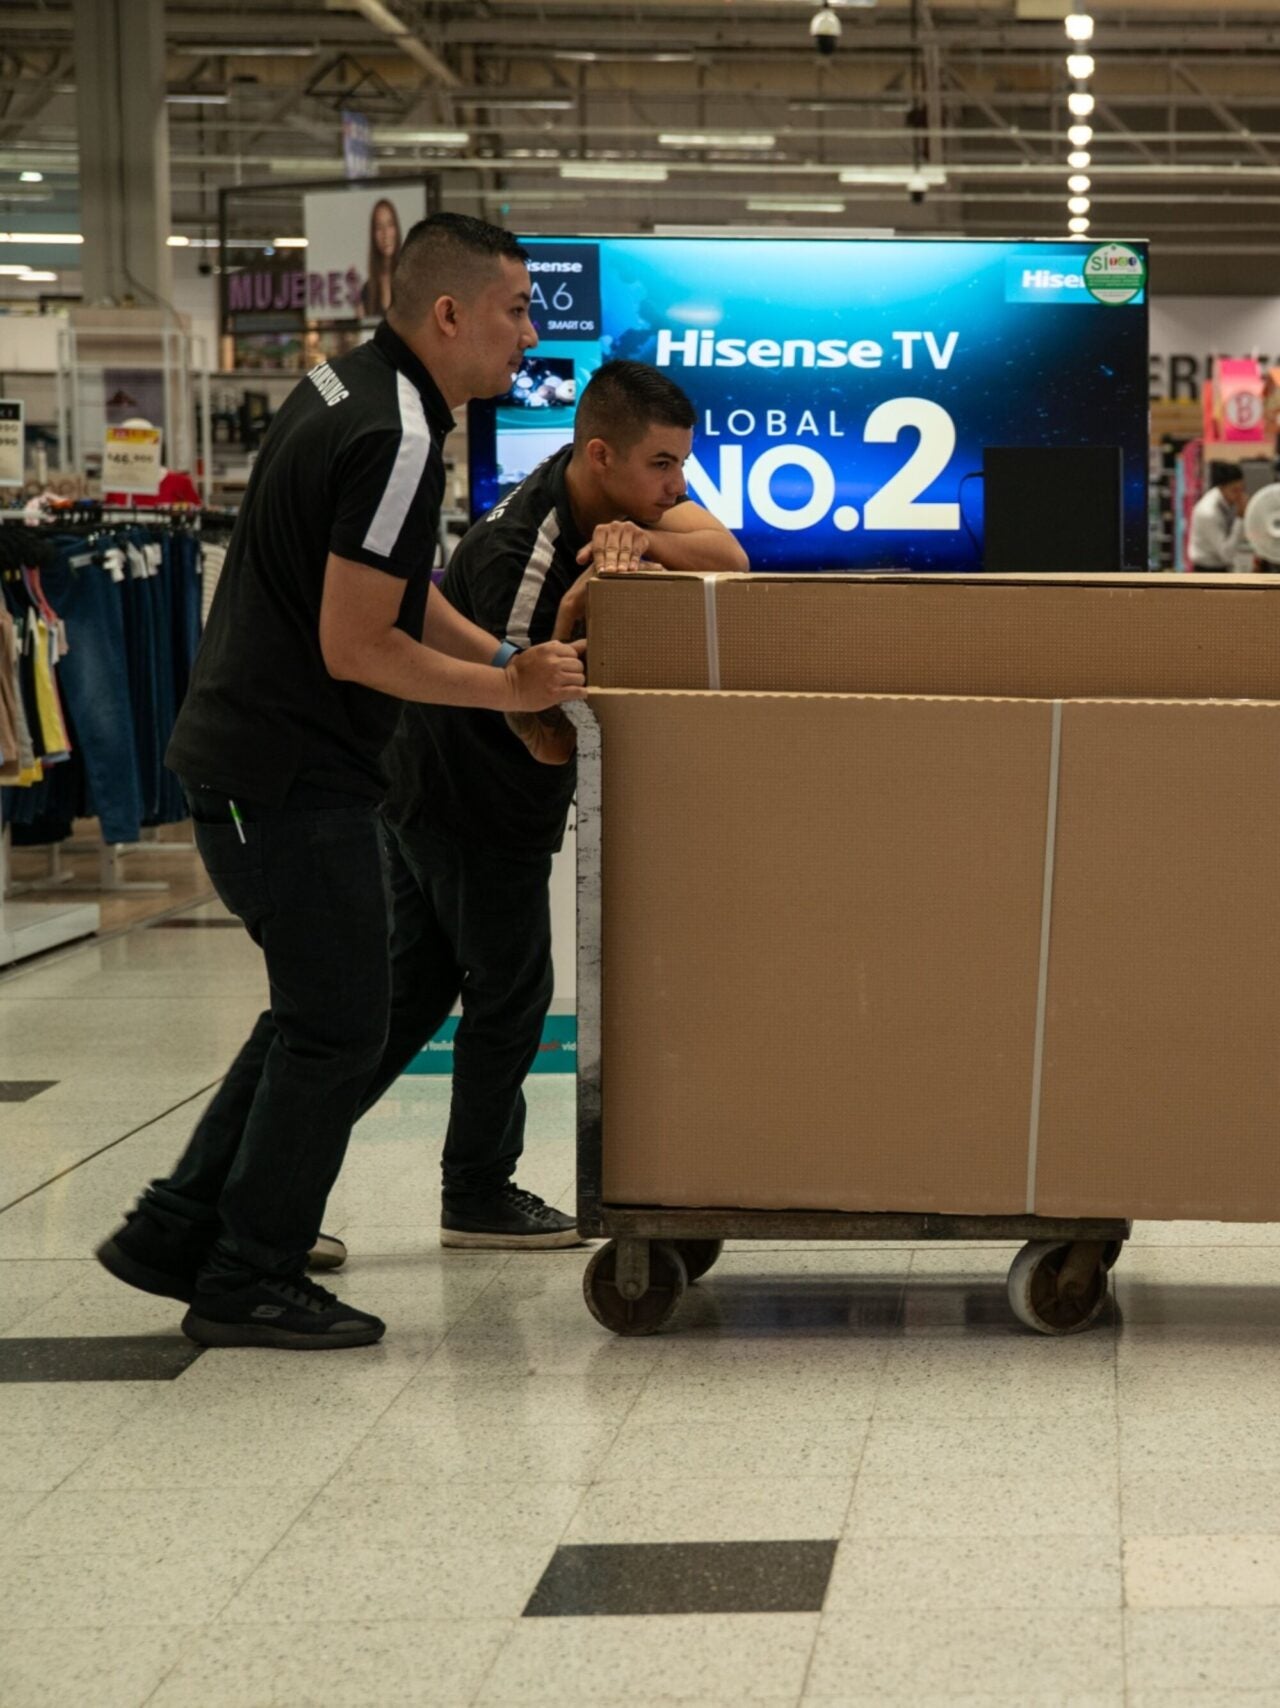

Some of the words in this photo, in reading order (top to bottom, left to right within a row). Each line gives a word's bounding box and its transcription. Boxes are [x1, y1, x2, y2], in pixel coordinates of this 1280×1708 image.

[526, 259, 583, 273] isense
[228, 268, 362, 311] MUJERES
[1022, 270, 1086, 288] Hise
[547, 320, 579, 330] SMART
[579, 320, 595, 330] OS
[656, 329, 884, 368] Hisense
[892, 331, 959, 369] TV
[705, 409, 845, 437] LOBAL
